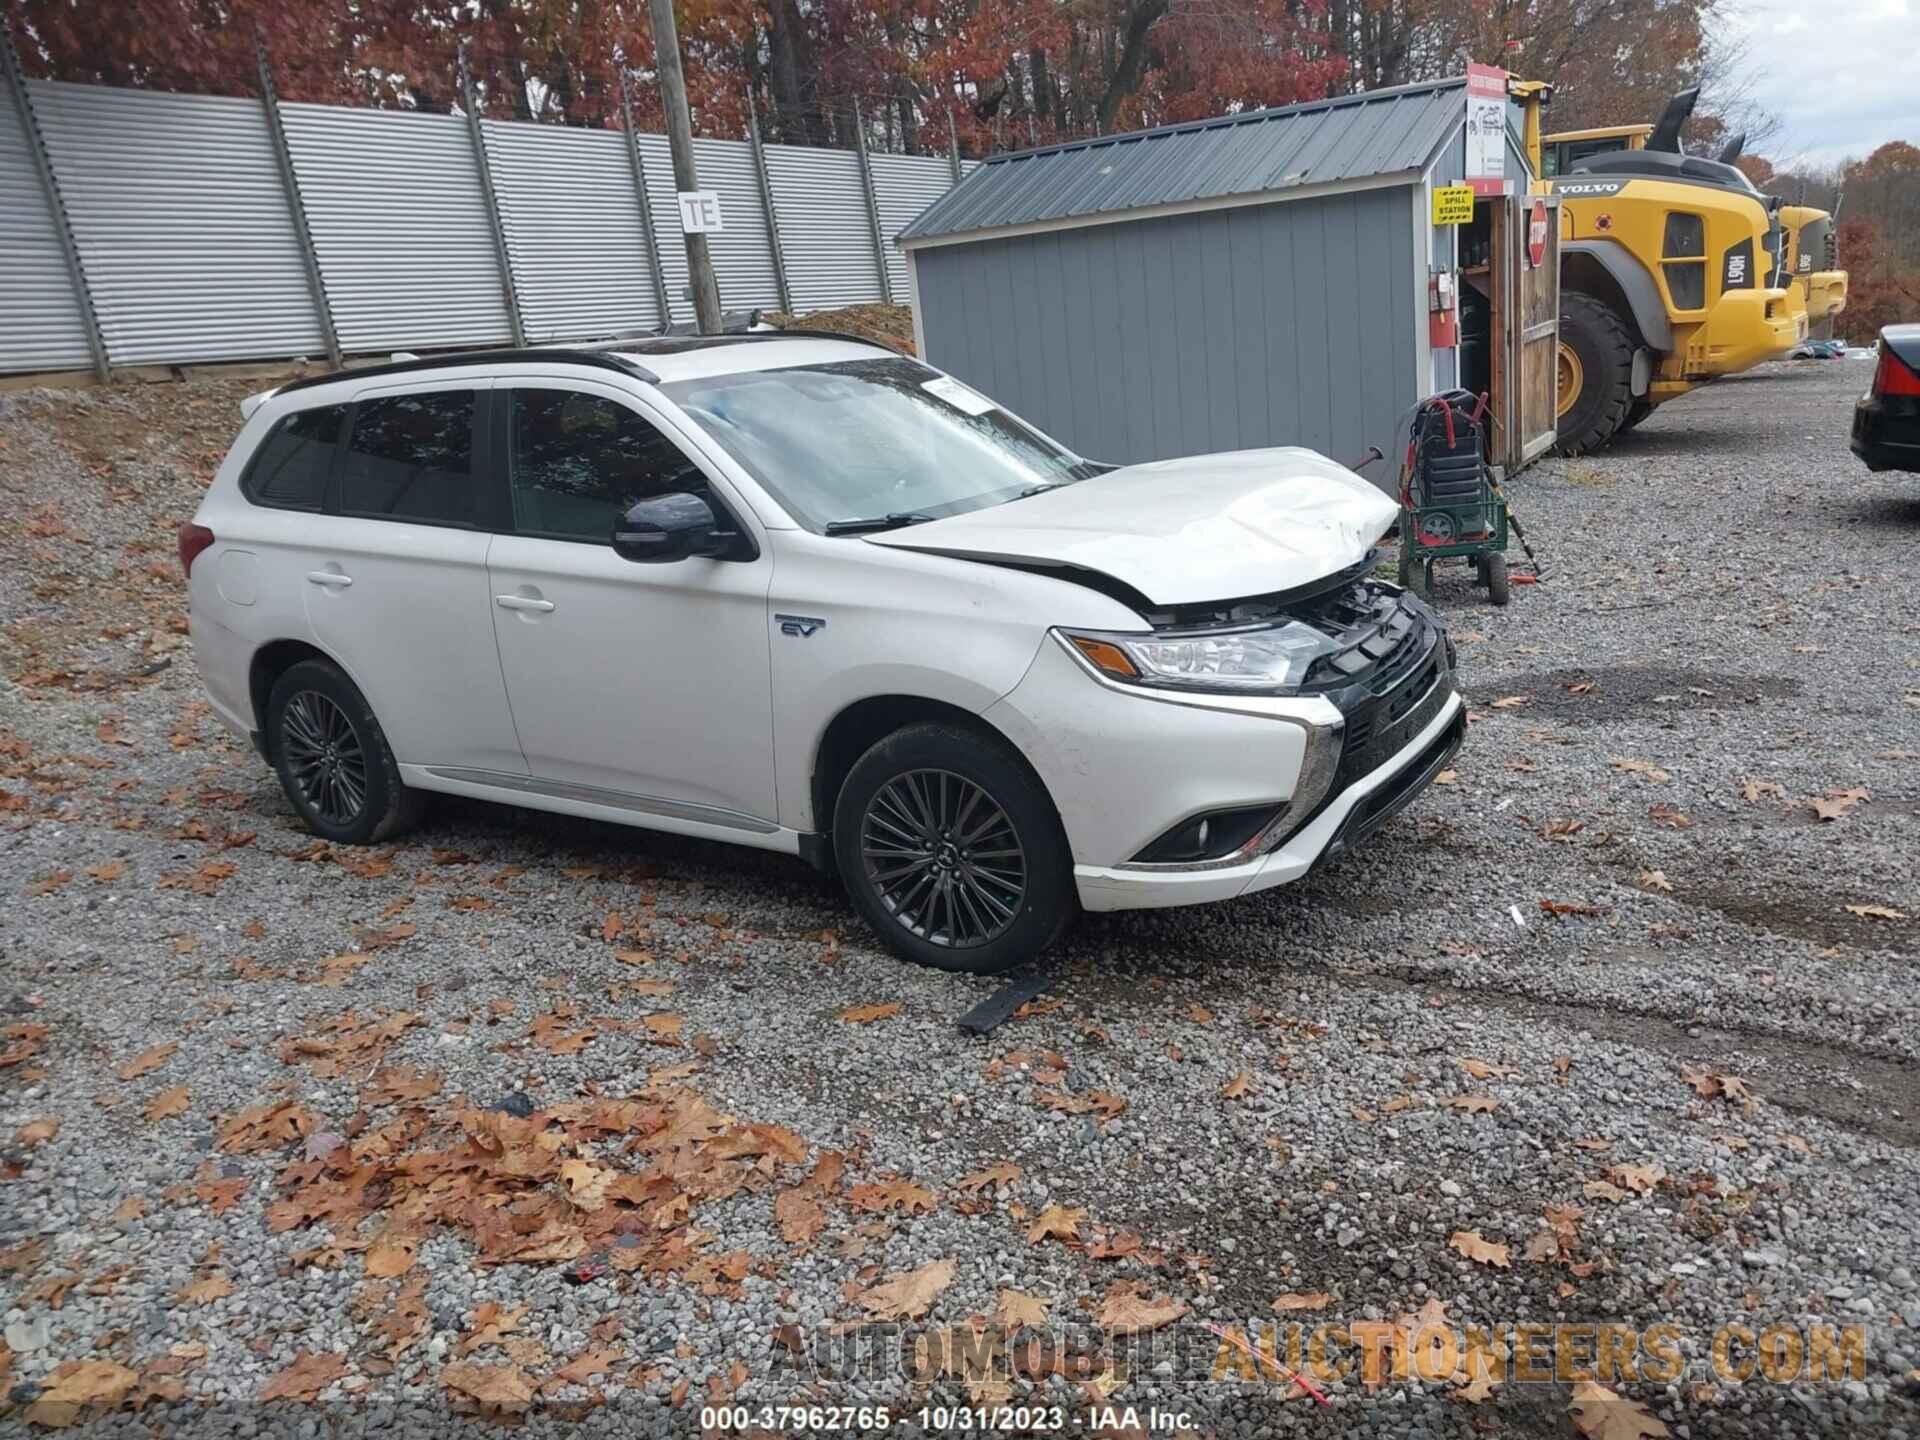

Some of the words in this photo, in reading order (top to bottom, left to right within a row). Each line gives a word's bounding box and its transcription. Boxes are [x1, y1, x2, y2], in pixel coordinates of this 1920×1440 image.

[1558, 184, 1619, 194] VOLVO
[1444, 196, 1465, 206] SPILL
[684, 199, 717, 226] TE
[1439, 206, 1471, 215] STATION
[1727, 255, 1746, 284] L90H
[781, 622, 817, 638] EV
